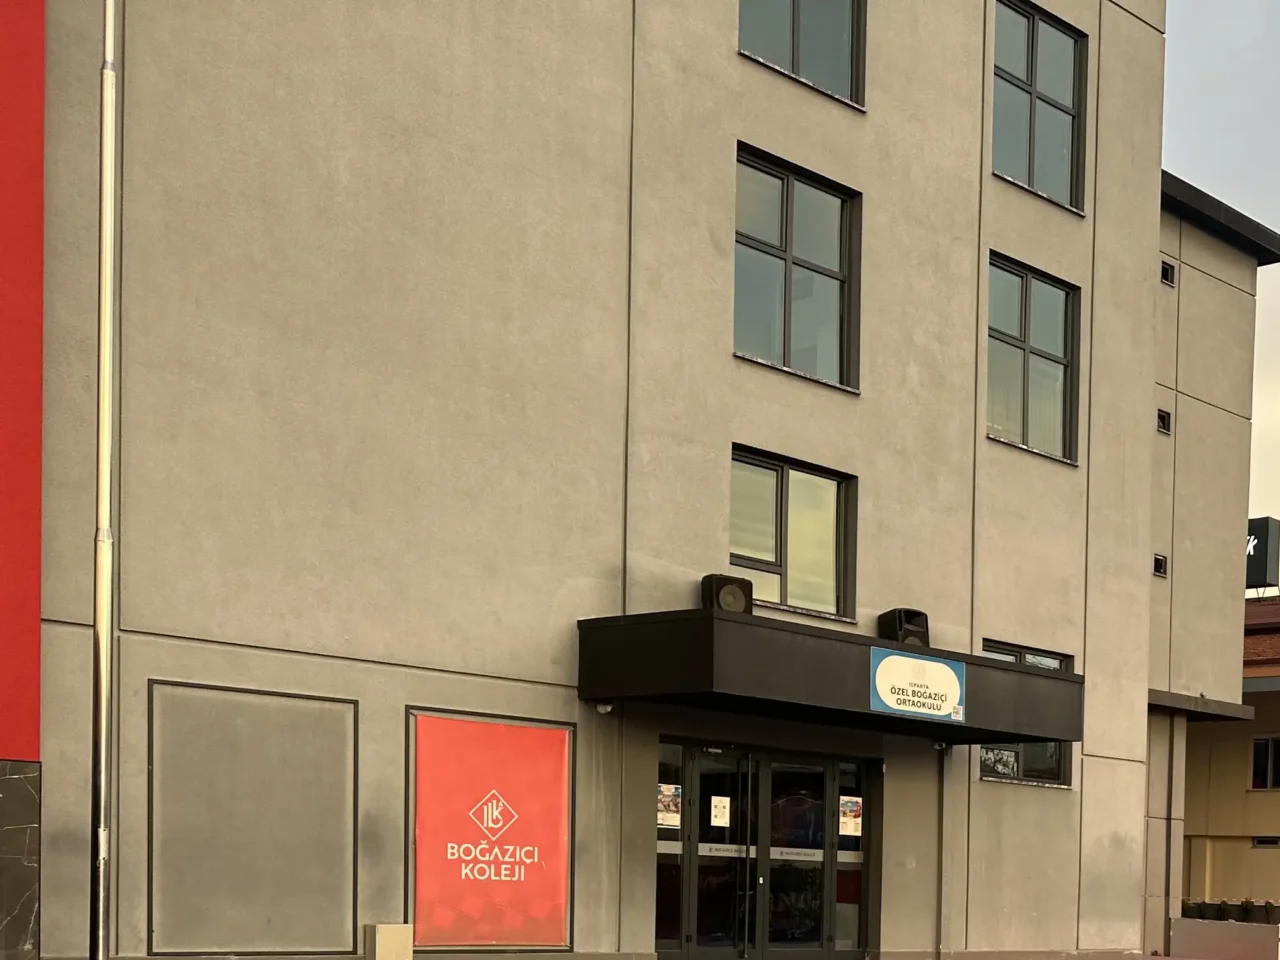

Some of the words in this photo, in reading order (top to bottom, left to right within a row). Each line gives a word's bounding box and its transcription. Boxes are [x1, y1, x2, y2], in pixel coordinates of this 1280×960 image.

[890, 685, 910, 697] ÖZEL
[911, 690, 947, 704] BOĞAZİÇİ
[896, 698, 942, 711] ORTAOKULU
